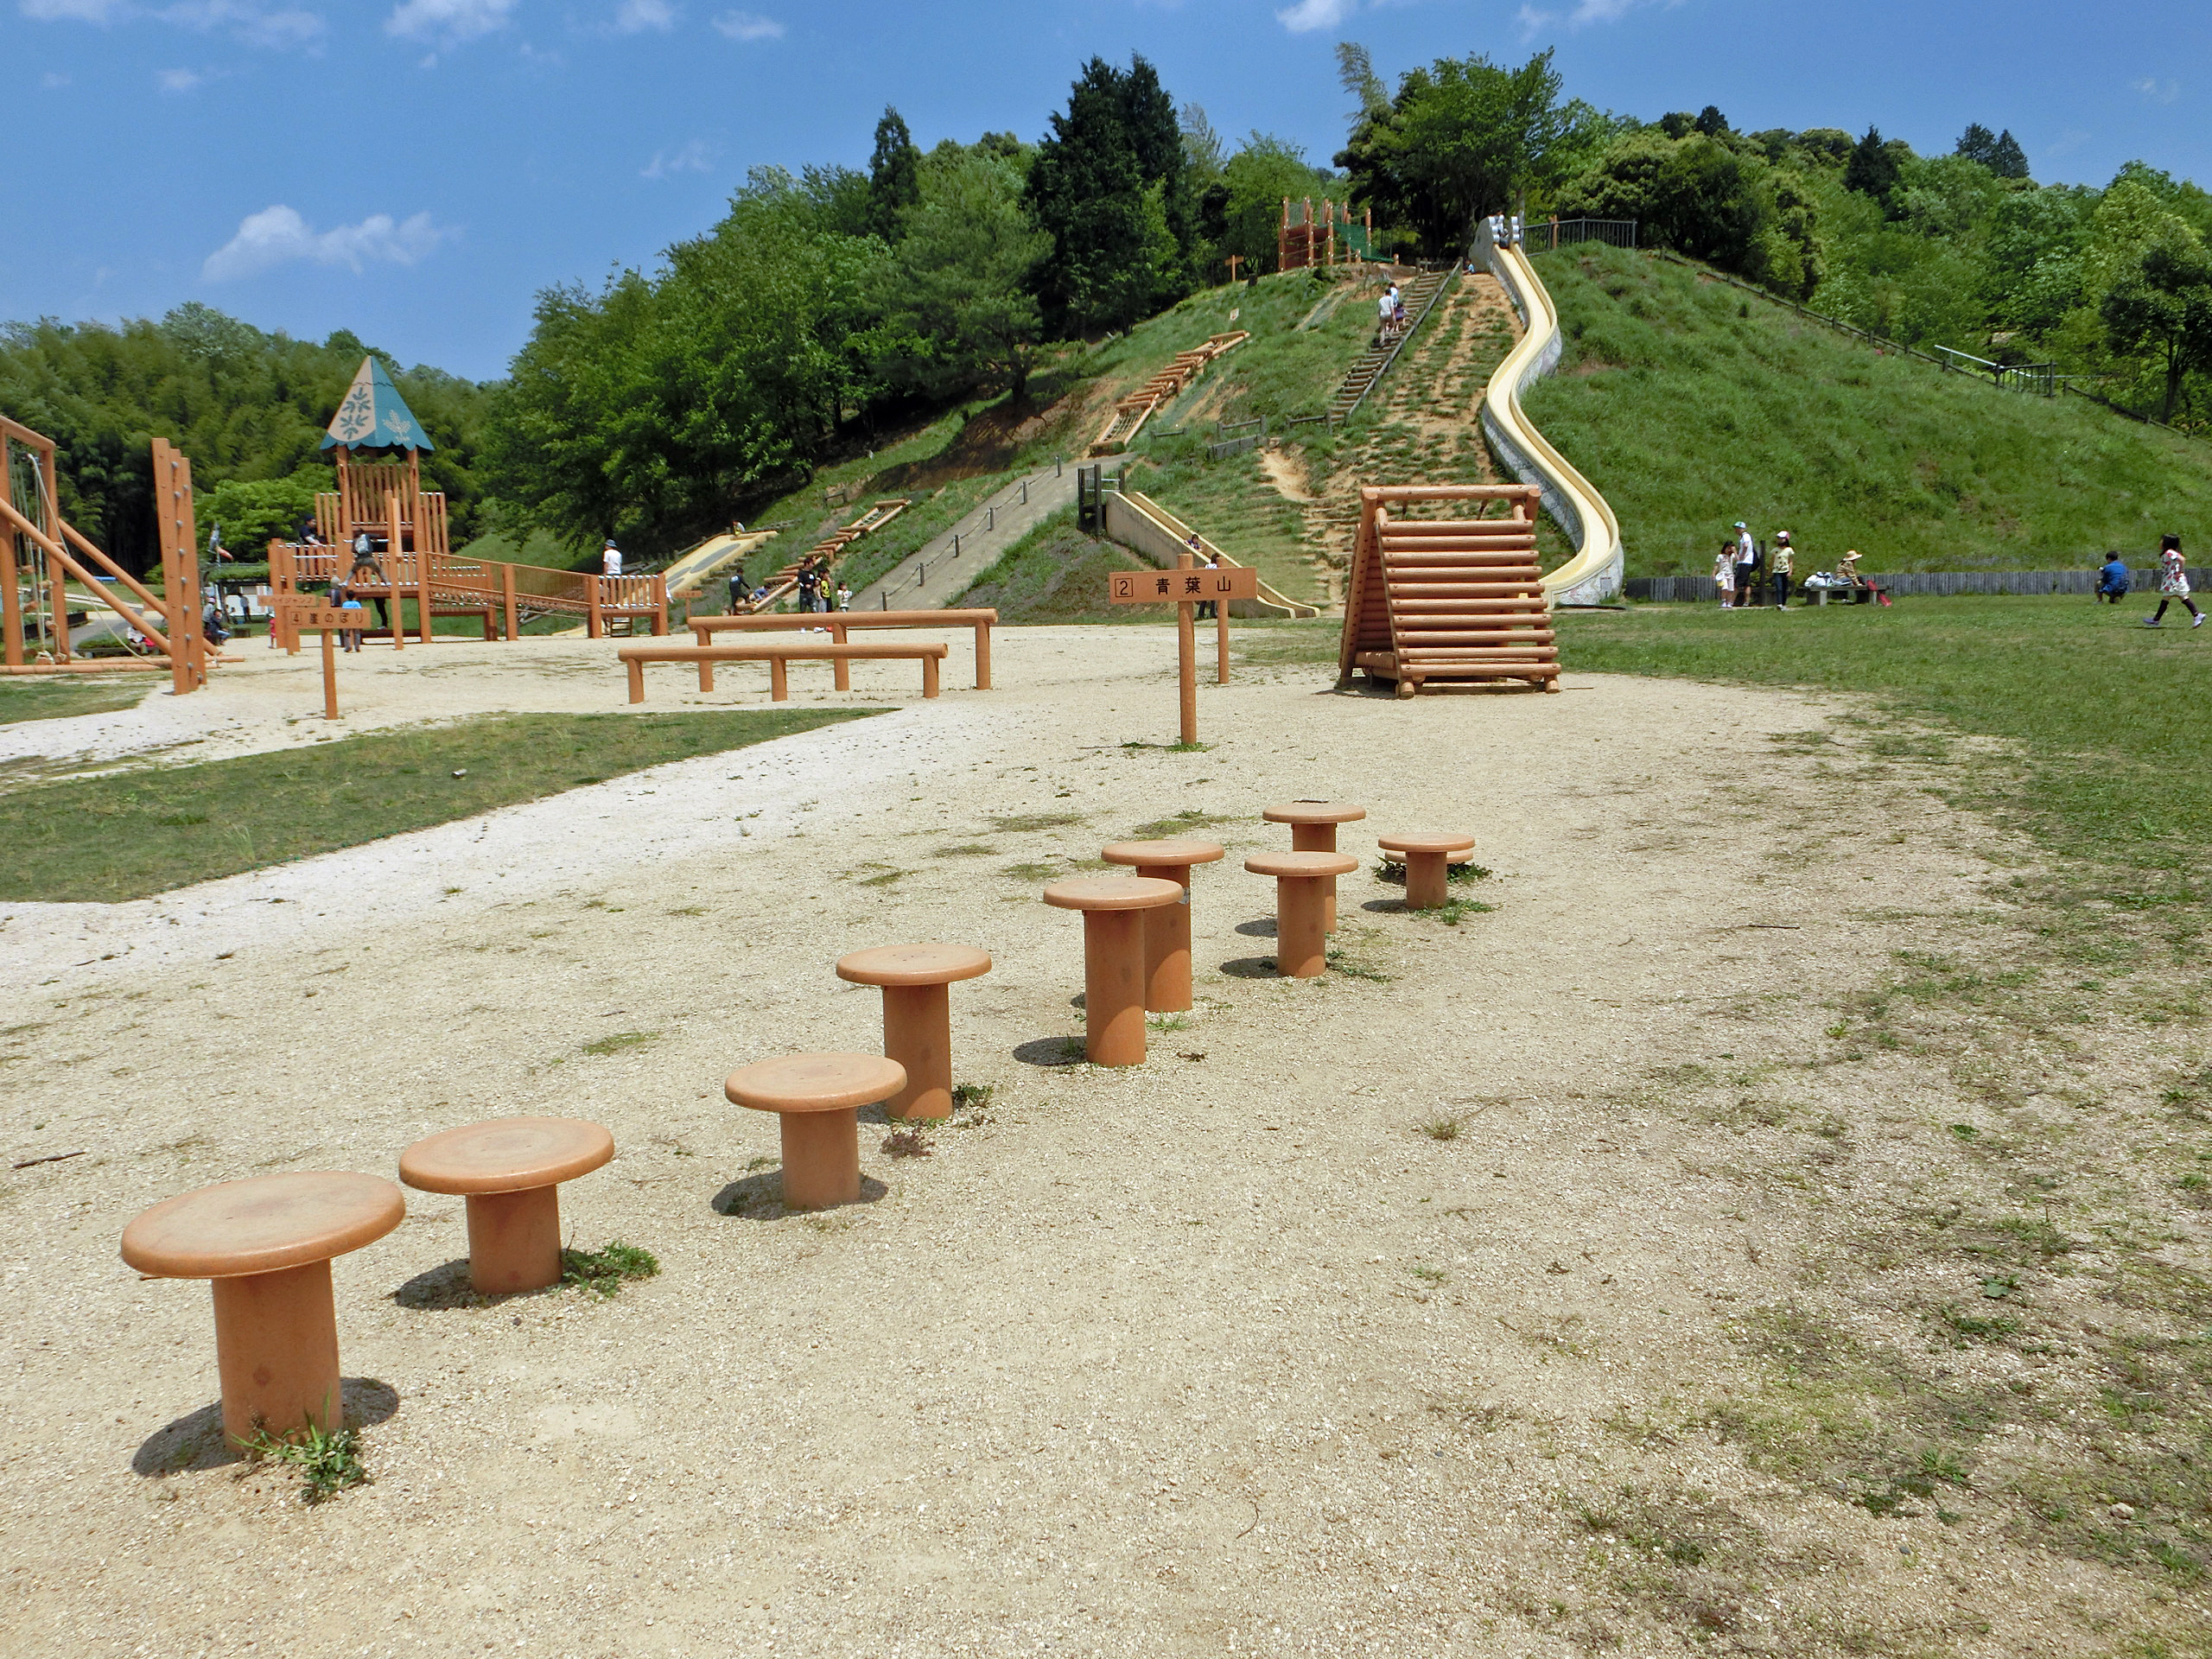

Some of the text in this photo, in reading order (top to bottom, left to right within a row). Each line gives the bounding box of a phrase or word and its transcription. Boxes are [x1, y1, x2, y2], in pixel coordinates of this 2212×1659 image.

[1119, 575, 1231, 595] 2 青葉山
